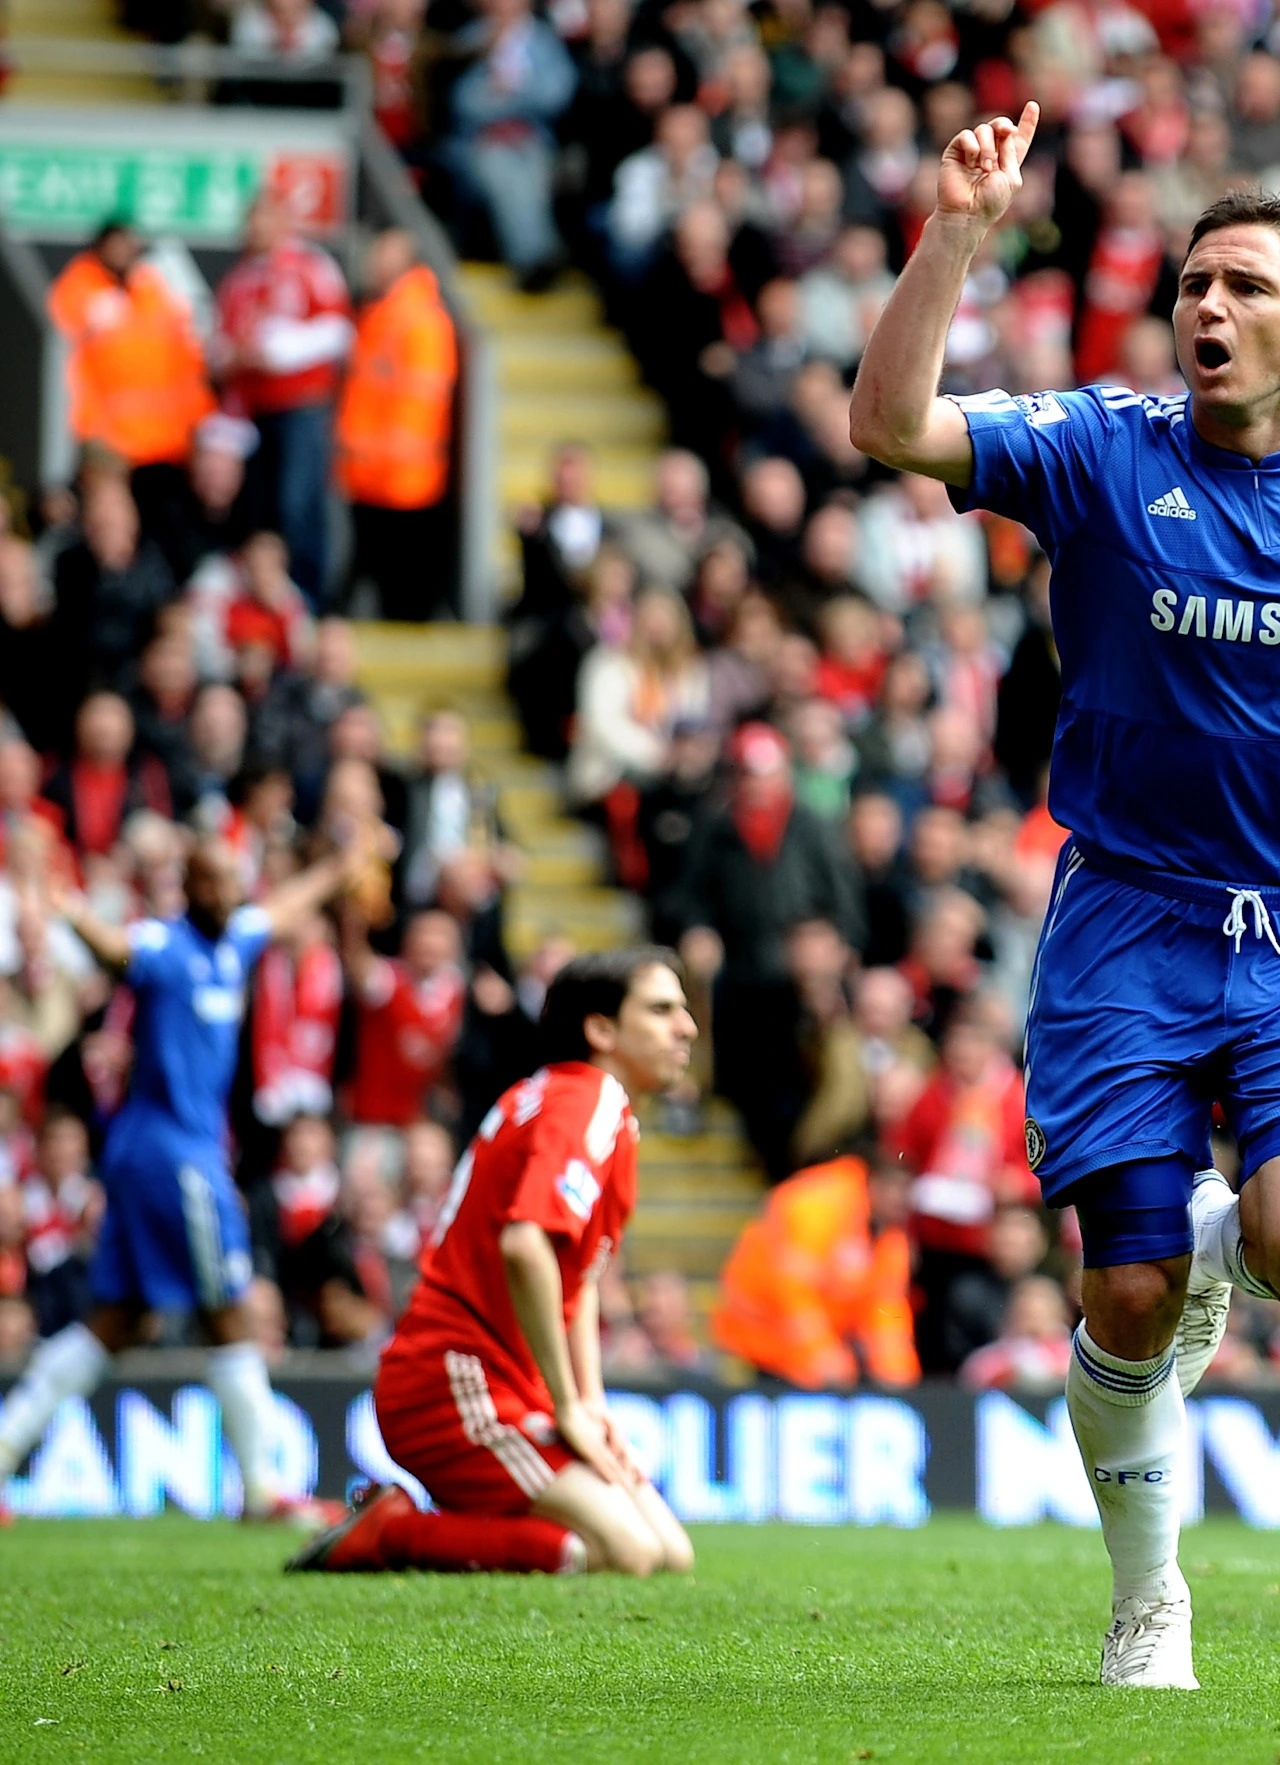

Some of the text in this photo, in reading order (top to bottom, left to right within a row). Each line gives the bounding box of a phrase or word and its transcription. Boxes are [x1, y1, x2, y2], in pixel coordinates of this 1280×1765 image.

[1147, 503, 1197, 520] adidas
[0, 1385, 319, 1521] AND
[1094, 1467, 1163, 1485] CFC
